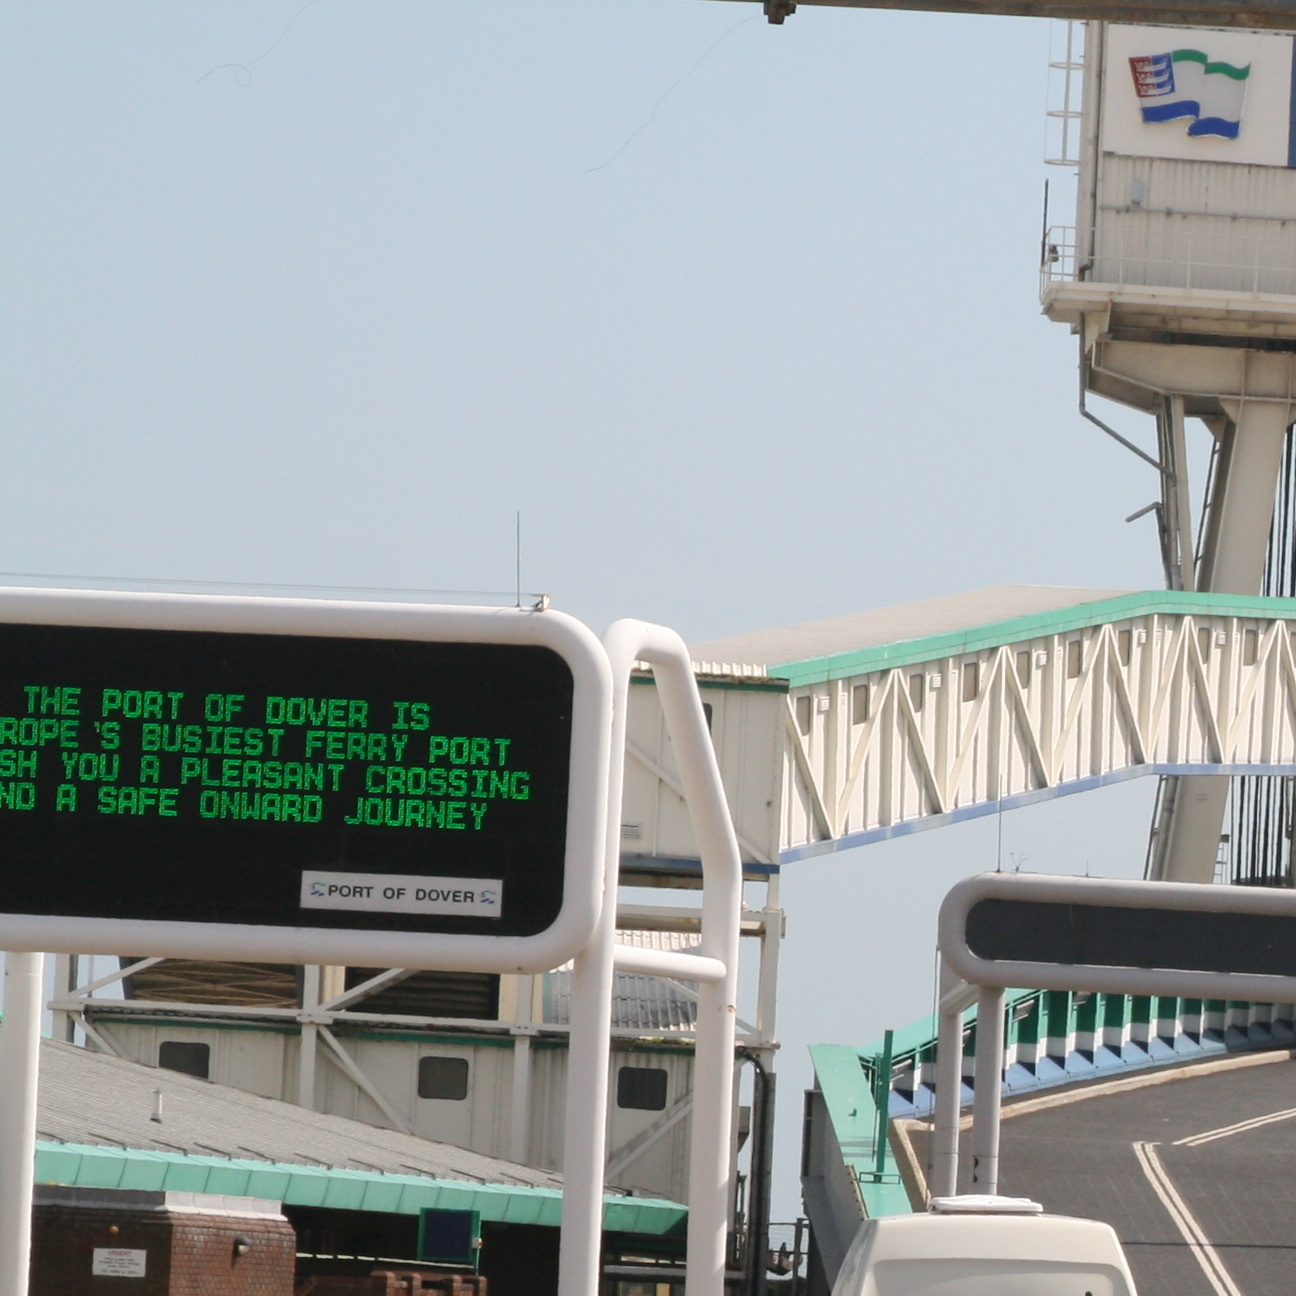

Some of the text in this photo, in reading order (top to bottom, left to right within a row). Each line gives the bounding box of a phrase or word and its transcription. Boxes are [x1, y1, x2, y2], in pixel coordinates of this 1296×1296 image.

[25, 686, 431, 730] THE PORT OF DOVER IS
[142, 723, 285, 756] BUSIEST
[305, 730, 409, 761] FERRY
[428, 736, 511, 765] PORT
[61, 752, 120, 781] YOU
[140, 755, 160, 782] A
[181, 757, 345, 791] PLEASANT
[366, 766, 530, 800] CROSSING
[56, 784, 77, 811] A
[98, 786, 180, 816] SAFE
[200, 790, 324, 823] ONWARD
[346, 798, 488, 829] JOURNEY
[328, 885, 475, 903] PORT OF DOVER
